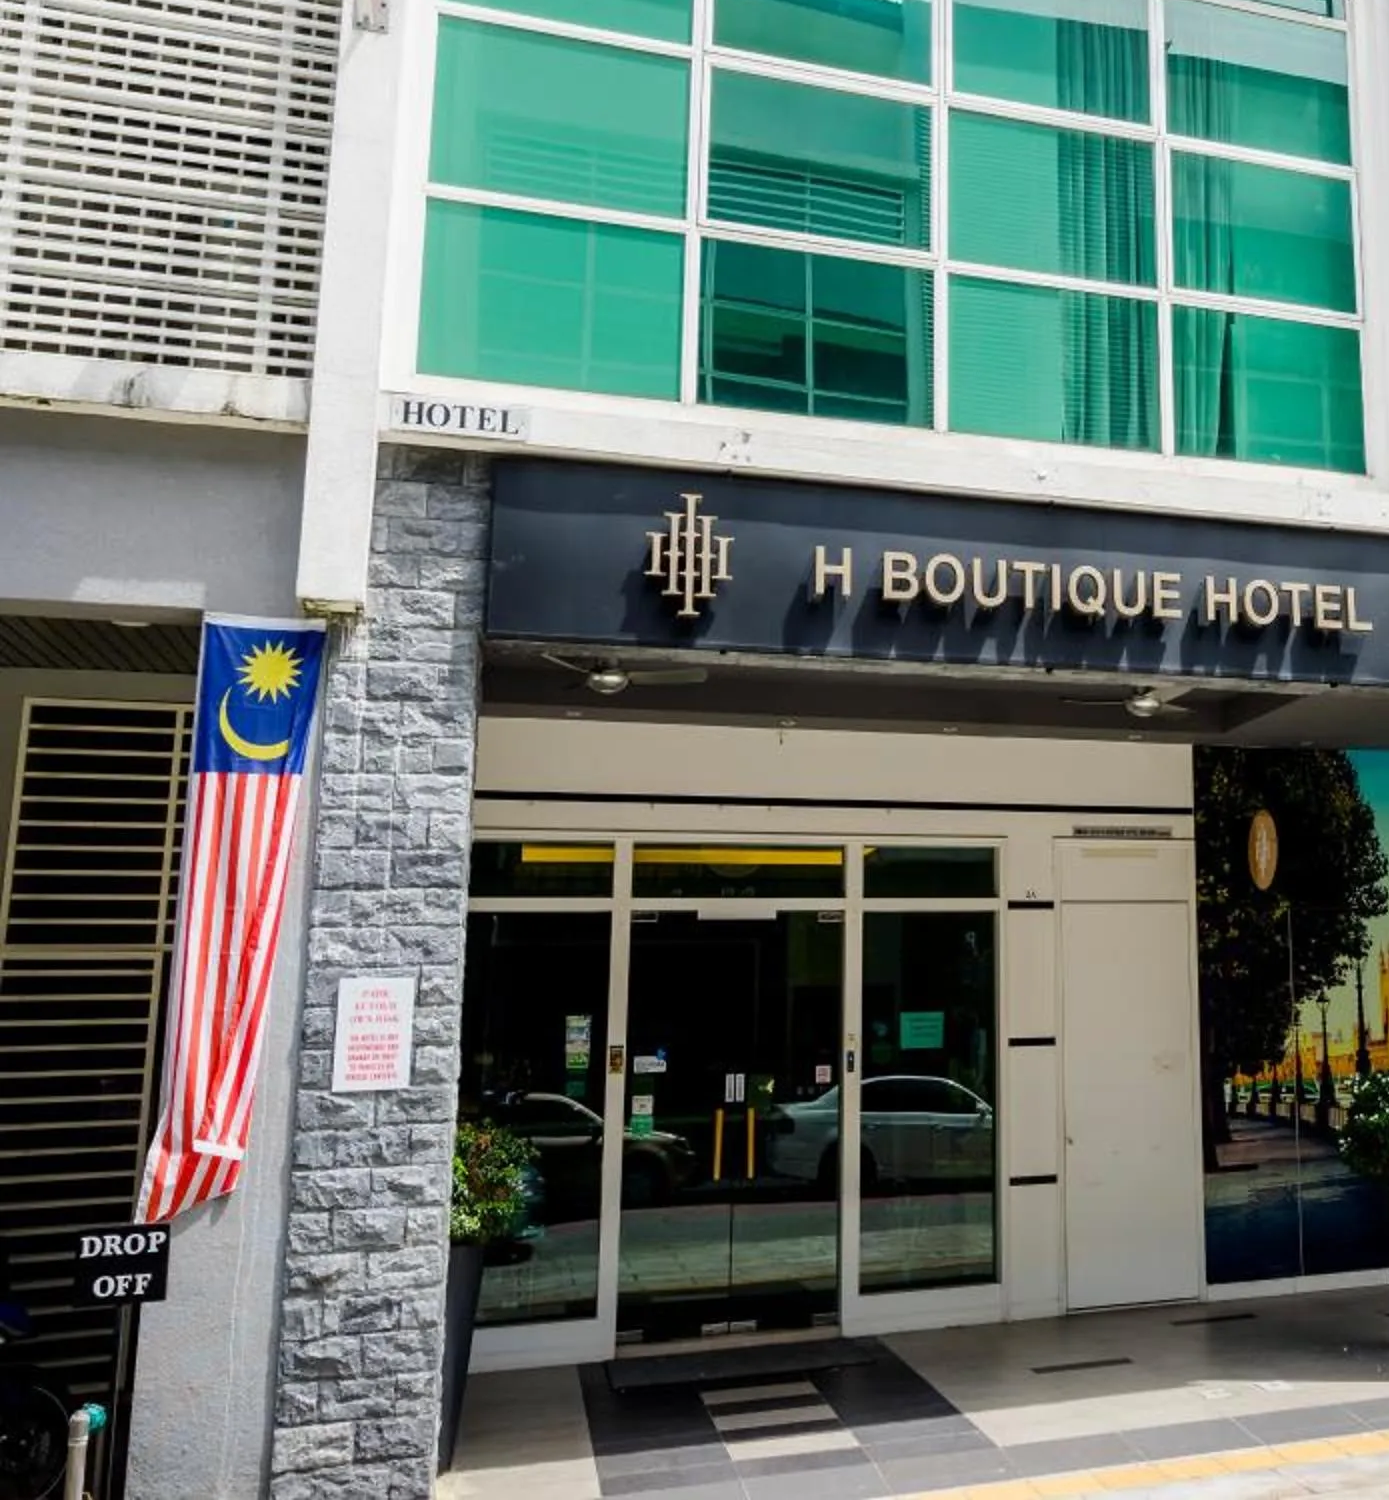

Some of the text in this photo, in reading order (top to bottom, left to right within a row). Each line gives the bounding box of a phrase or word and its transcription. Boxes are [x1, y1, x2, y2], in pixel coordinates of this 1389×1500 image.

[403, 400, 519, 435] HOTEL
[814, 545, 1373, 632] H BOUTIQUE HOTEL
[80, 1231, 167, 1259] DROP
[93, 1273, 153, 1298] OFF
